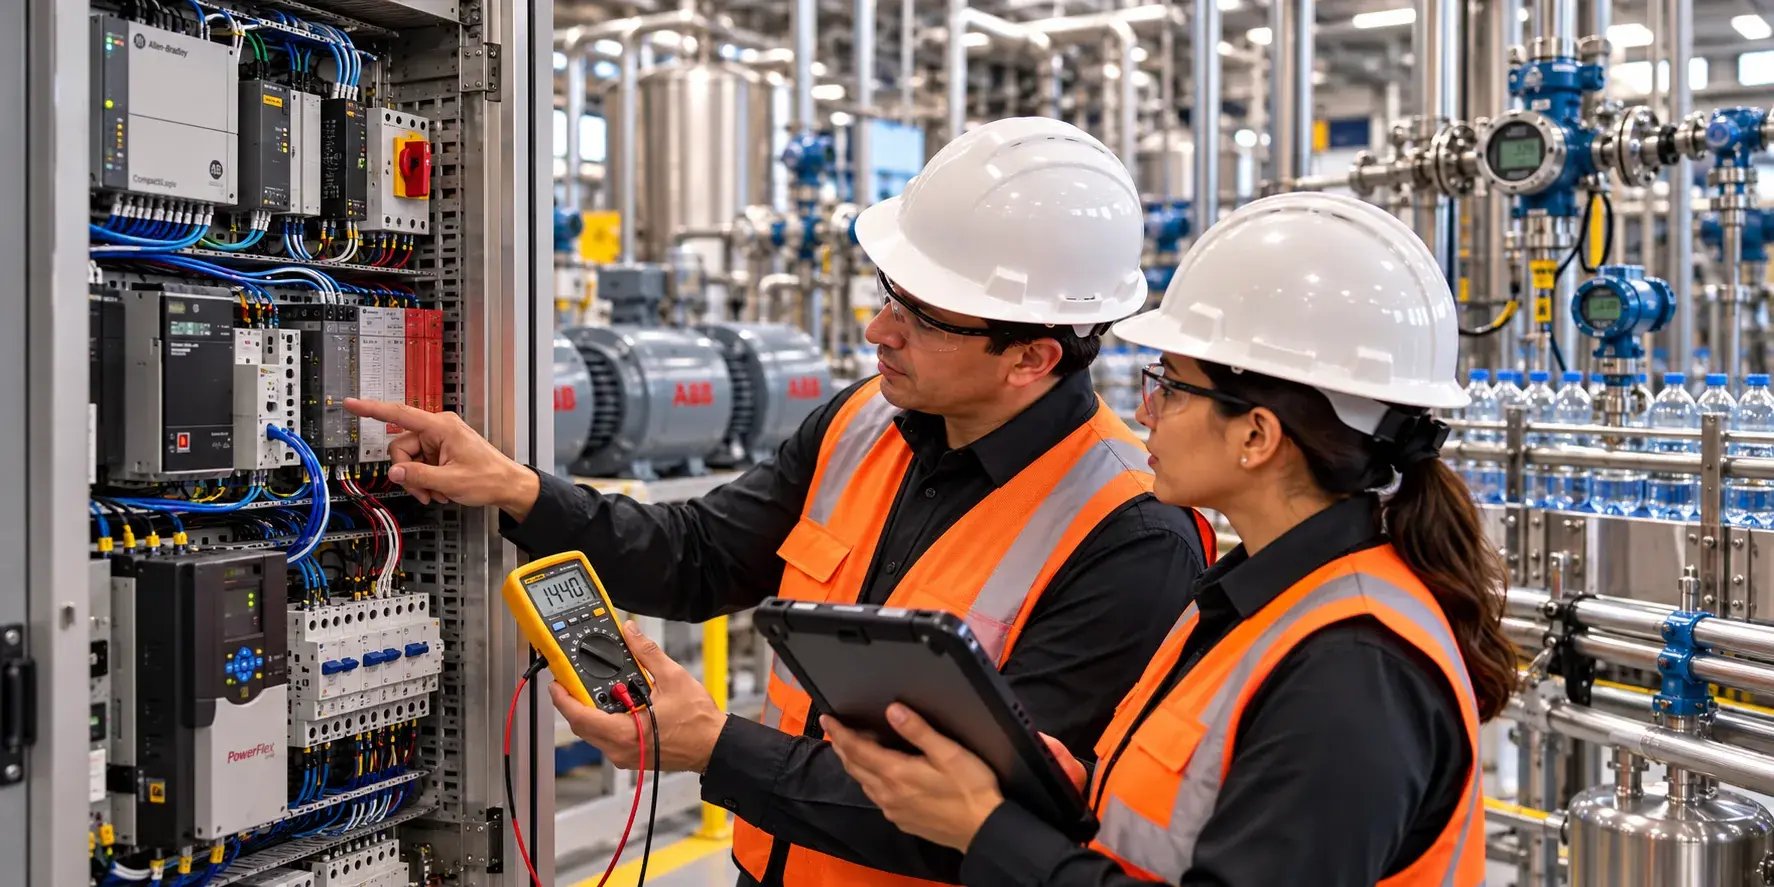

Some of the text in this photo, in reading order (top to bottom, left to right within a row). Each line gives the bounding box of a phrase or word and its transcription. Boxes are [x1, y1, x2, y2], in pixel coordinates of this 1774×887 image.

[673, 381, 714, 407] ABB
[788, 377, 821, 399] ABB
[543, 577, 584, 606] 1440
[227, 741, 275, 764] PowerFlex
